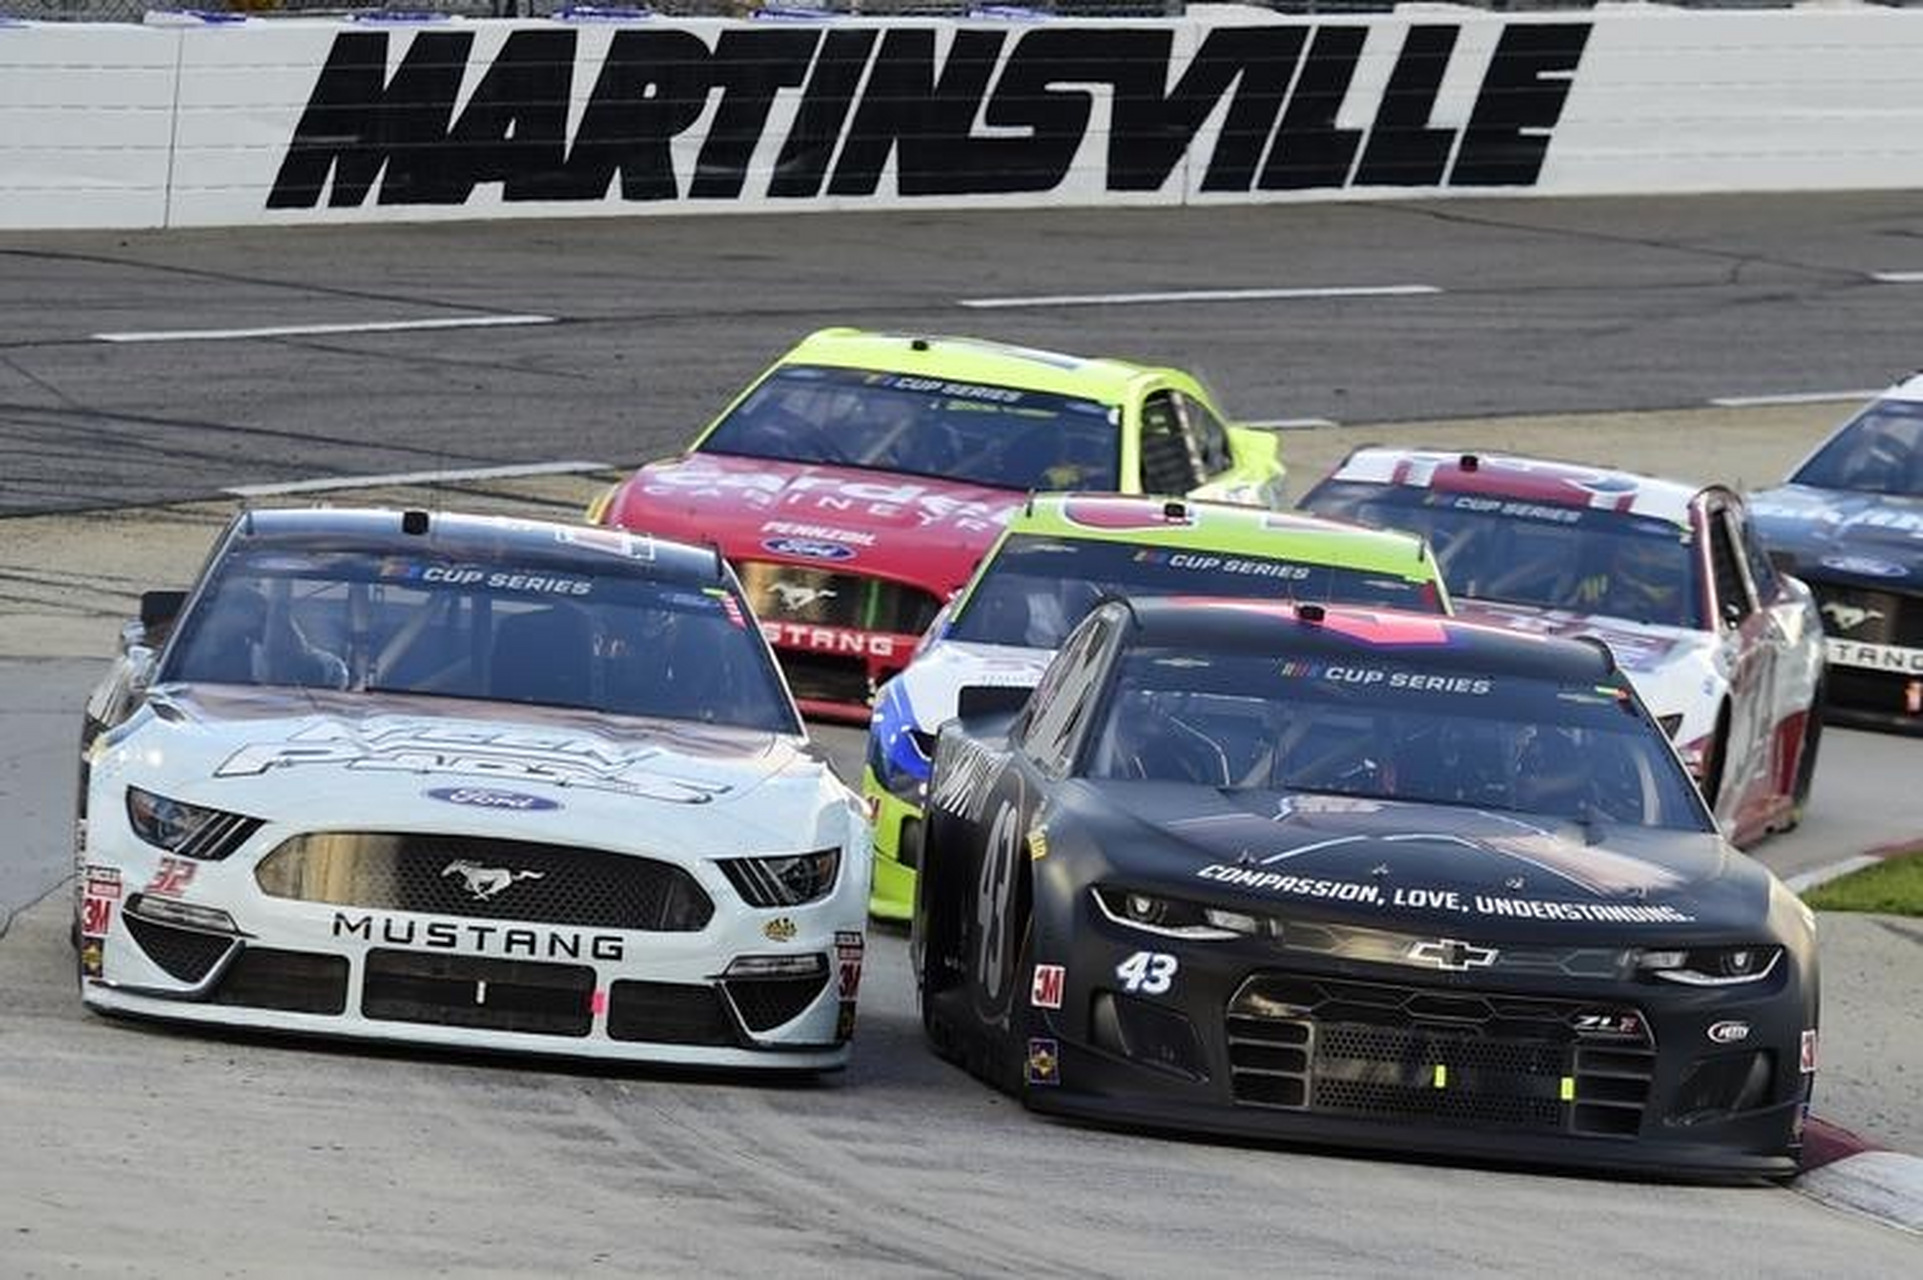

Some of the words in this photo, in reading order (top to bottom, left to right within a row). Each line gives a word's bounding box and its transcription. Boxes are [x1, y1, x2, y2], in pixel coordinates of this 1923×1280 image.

[266, 23, 1592, 209] MARTINSVILLE
[895, 376, 942, 392] CUP
[942, 382, 1024, 402] SERIES
[1454, 497, 1501, 512] CUP
[1501, 503, 1583, 523] SERIES
[422, 566, 483, 585] CUP
[486, 573, 593, 596] SERIES
[1168, 553, 1220, 571] CUP
[1222, 560, 1311, 581] SERIES
[761, 621, 894, 657] STANG
[1325, 666, 1384, 684] CUP
[1388, 674, 1493, 695] SERIES
[449, 788, 534, 808] Ford
[144, 857, 198, 898] 32
[1196, 864, 1386, 906] COMPASSION,
[82, 898, 112, 935] 3M
[332, 912, 625, 961] MUSTANG
[1035, 966, 1062, 1007] 3M
[1115, 950, 1179, 995] 43
